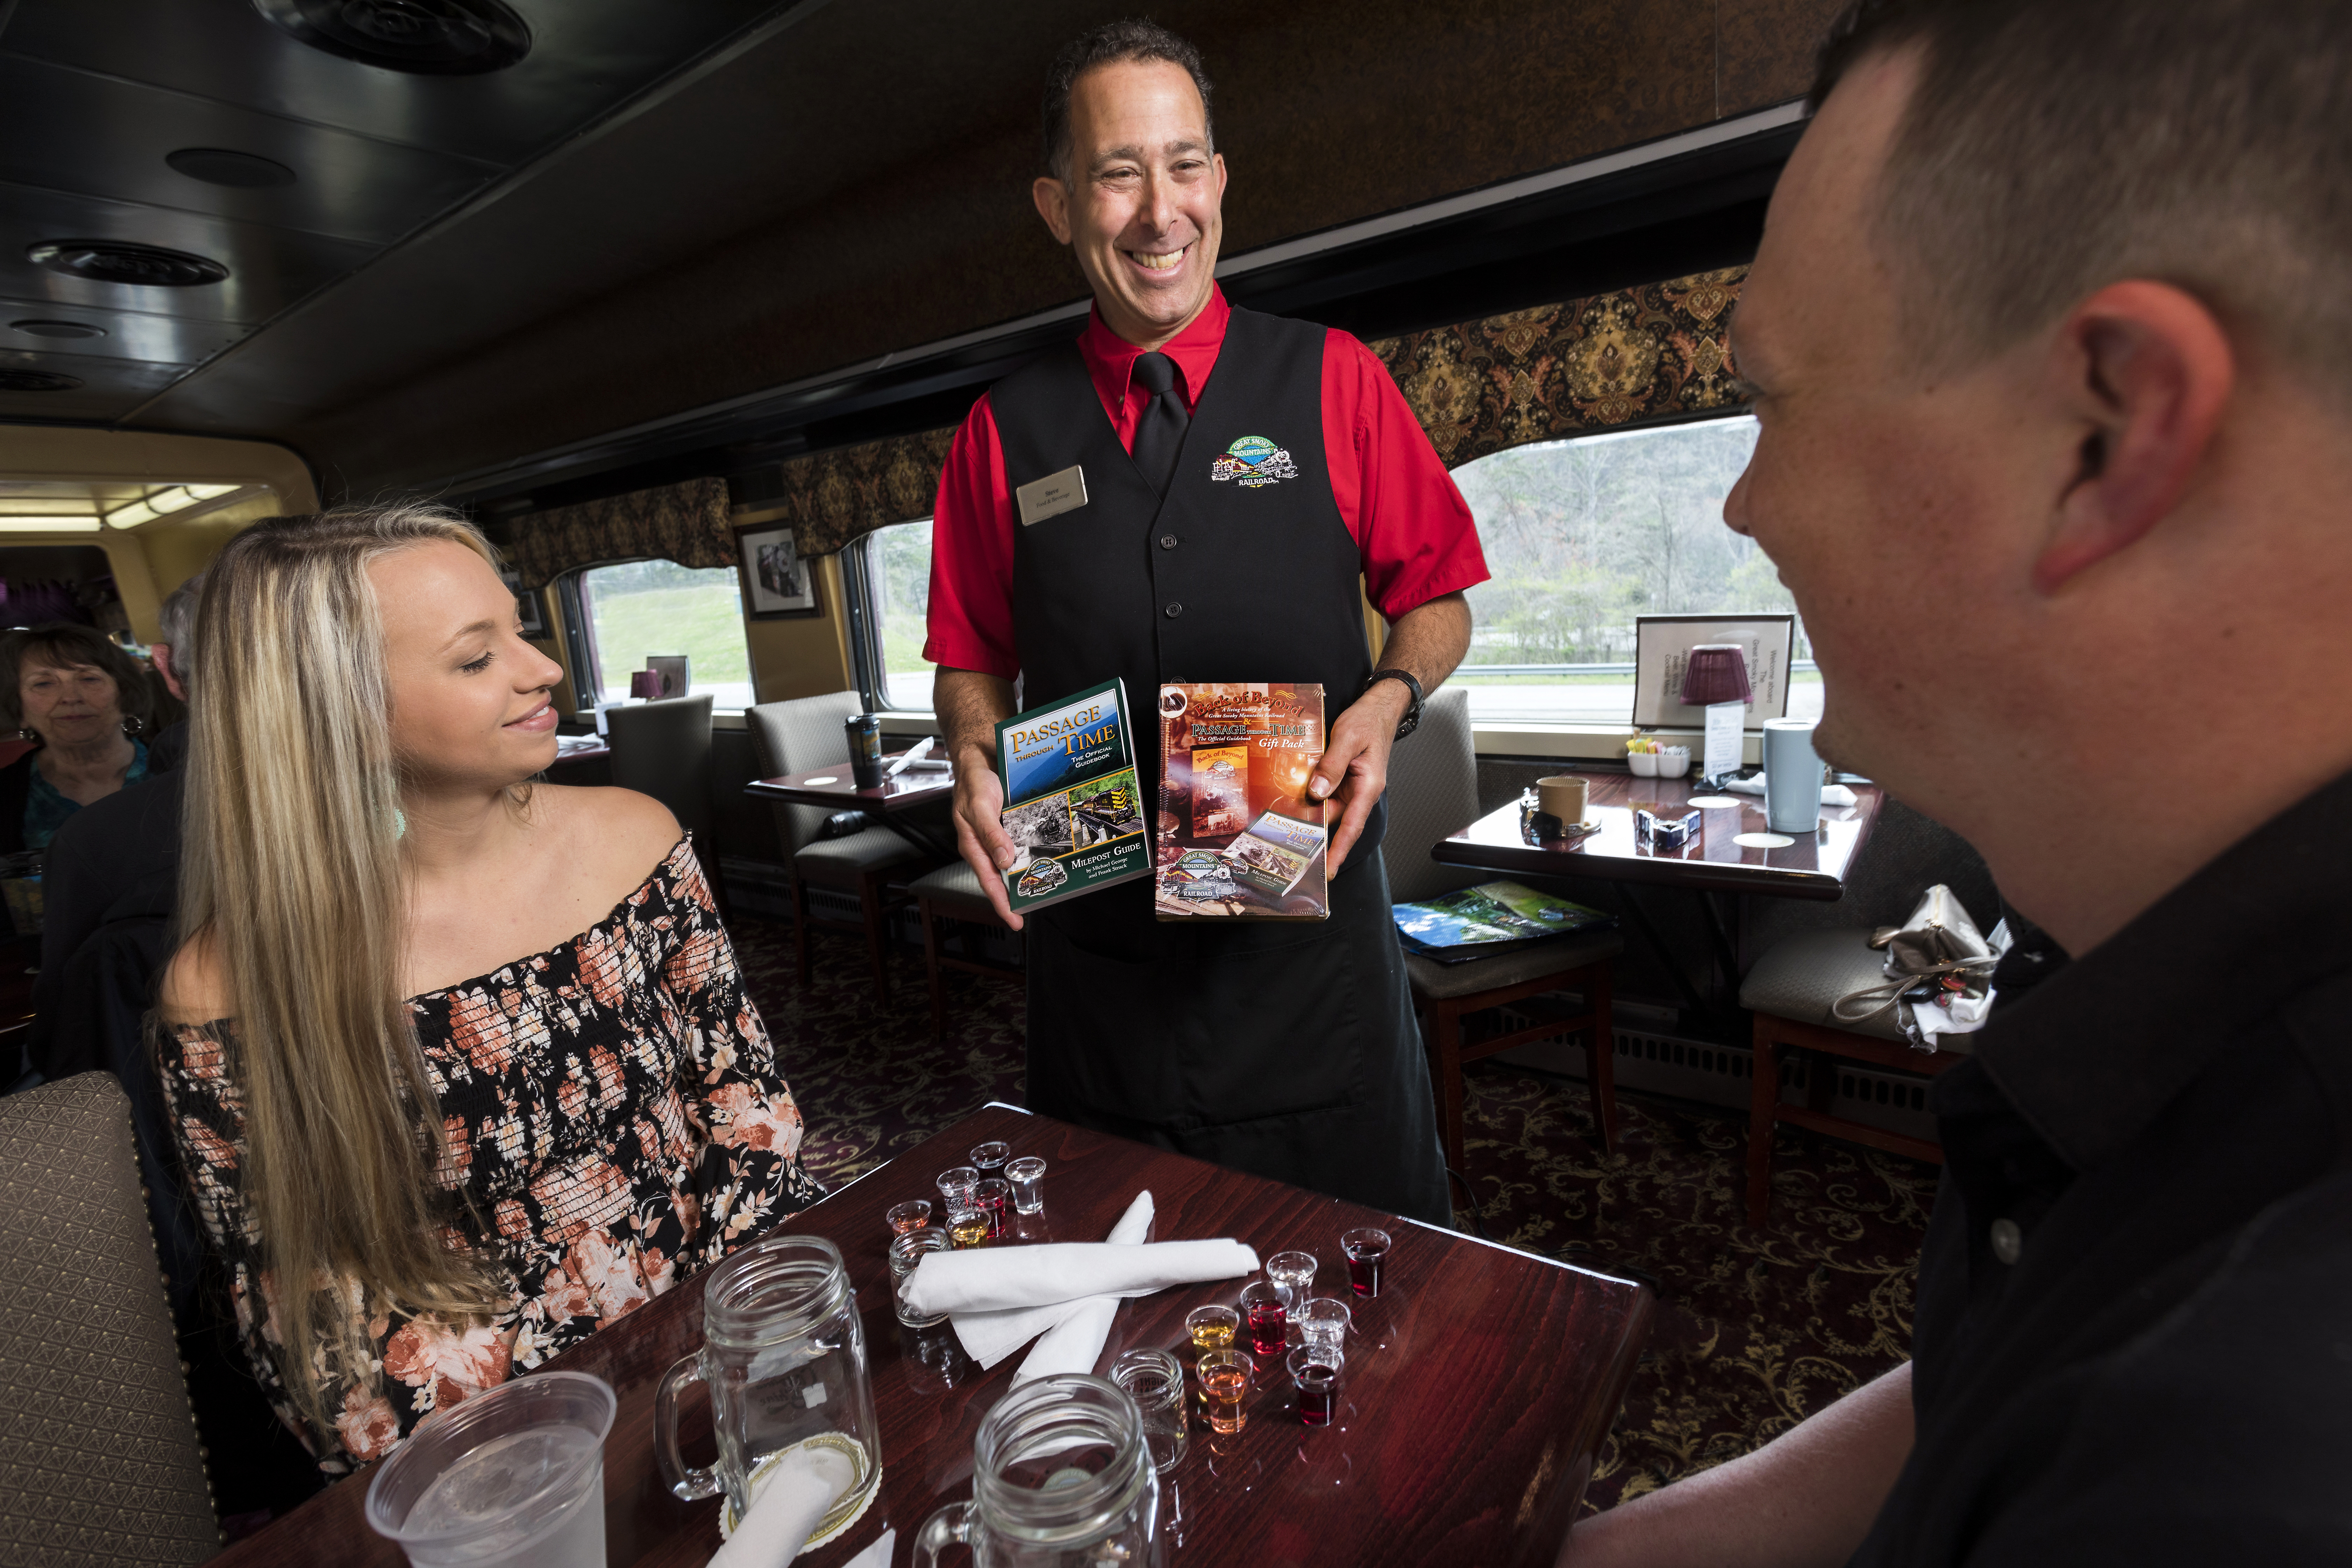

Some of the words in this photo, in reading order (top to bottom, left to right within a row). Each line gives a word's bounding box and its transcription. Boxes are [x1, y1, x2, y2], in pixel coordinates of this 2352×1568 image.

[1233, 439, 1250, 450] GREAT
[1252, 438, 1270, 448] SMOKY
[1234, 448, 1271, 456] MOUNTAINS
[1045, 488, 1059, 497] Steve
[1052, 492, 1070, 502] Beverage
[1751, 639, 1760, 658] Great
[1749, 659, 1759, 680] Smoky
[1768, 650, 1777, 680] Welcome
[1193, 695, 1230, 717] Back
[1232, 691, 1248, 703] of
[1251, 691, 1304, 717] Beyond
[1748, 682, 1757, 714] Mouains
[1011, 705, 1102, 753] PASSAGE
[1192, 724, 1246, 737] PASSAGE
[1269, 724, 1305, 737] TIME
[1016, 745, 1054, 762] THROUGH
[1058, 724, 1115, 756] TIME
[1259, 738, 1279, 749] Gift
[1281, 739, 1305, 748] Pack
[1085, 746, 1113, 758] OFFICIAL
[1196, 753, 1212, 763] Back
[1221, 750, 1244, 760] Beyond
[1075, 753, 1110, 768] GUIDEBOOK
[1265, 815, 1317, 836] PASSAGE
[1264, 822, 1284, 832] THROUGH
[1286, 830, 1316, 846] TIME
[1071, 851, 1111, 870] MILEPOST
[1114, 843, 1141, 856] GUIDE
[1183, 852, 1198, 863] GREAT
[1198, 852, 1214, 863] SMOKY
[1030, 861, 1040, 870] GREAT
[1030, 865, 1052, 875] MOUNTAINS
[1092, 862, 1110, 871] Michael
[1111, 857, 1128, 866] George
[1251, 869, 1273, 880] MILEPOST
[1273, 877, 1287, 886] GUIDE
[1033, 884, 1052, 894] RAILROAD
